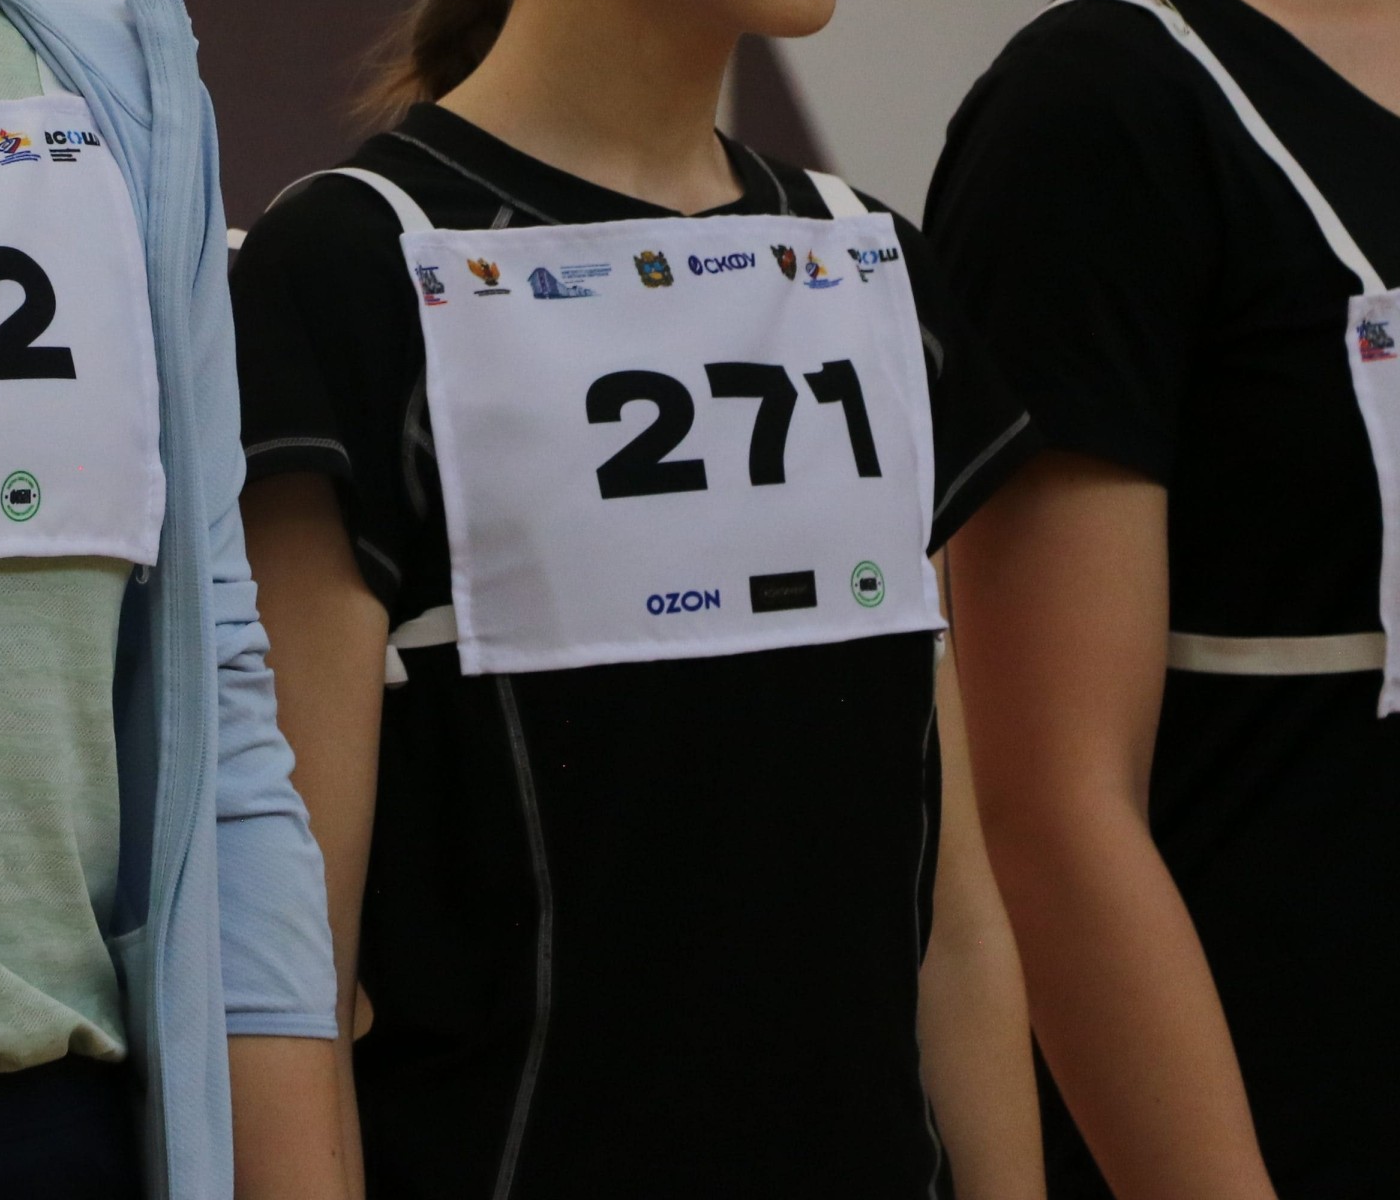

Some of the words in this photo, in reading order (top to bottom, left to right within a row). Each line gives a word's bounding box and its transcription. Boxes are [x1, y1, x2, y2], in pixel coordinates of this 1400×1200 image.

[703, 252, 756, 275] СКФУ
[585, 359, 883, 500] 271
[645, 588, 721, 617] OZON
